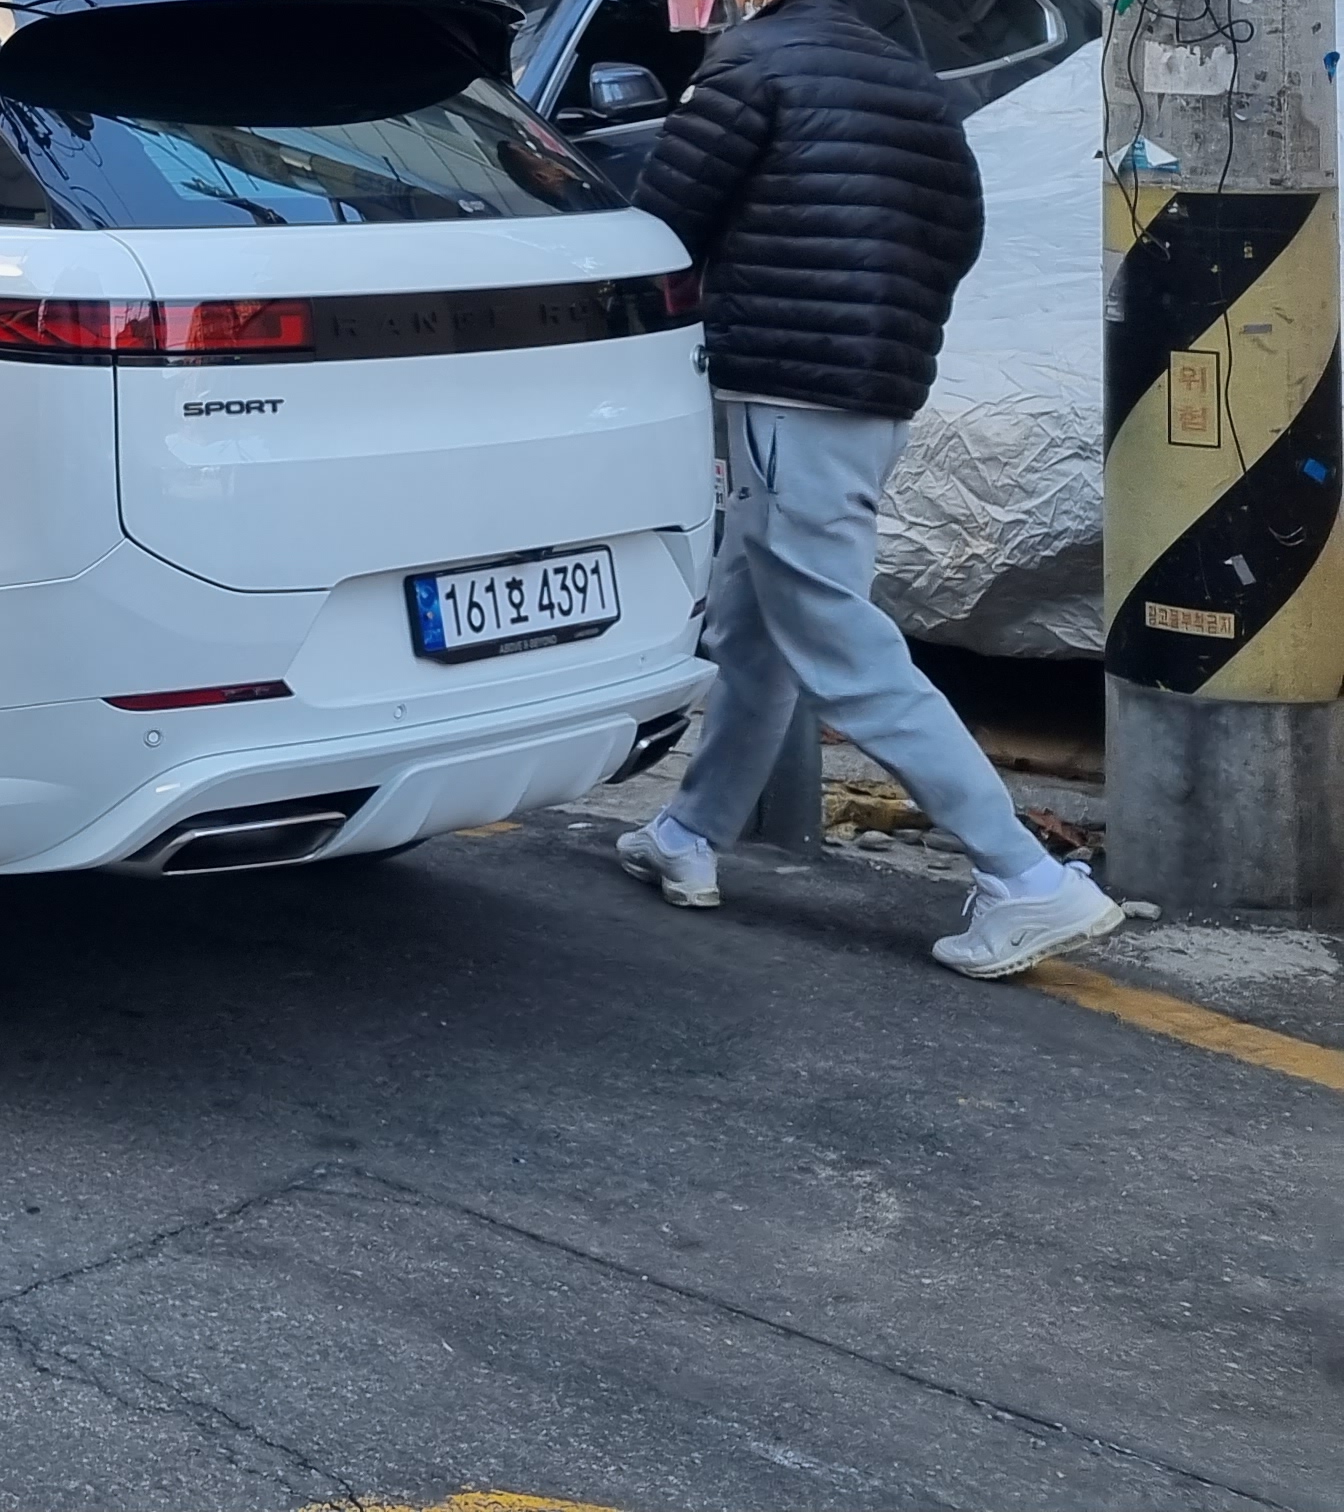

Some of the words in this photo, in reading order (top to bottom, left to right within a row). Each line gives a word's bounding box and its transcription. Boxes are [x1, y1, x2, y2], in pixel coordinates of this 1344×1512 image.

[182, 399, 285, 417] SPORT
[1178, 365, 1208, 433] 위험
[444, 576, 529, 636] 161호
[537, 559, 606, 620] 4391
